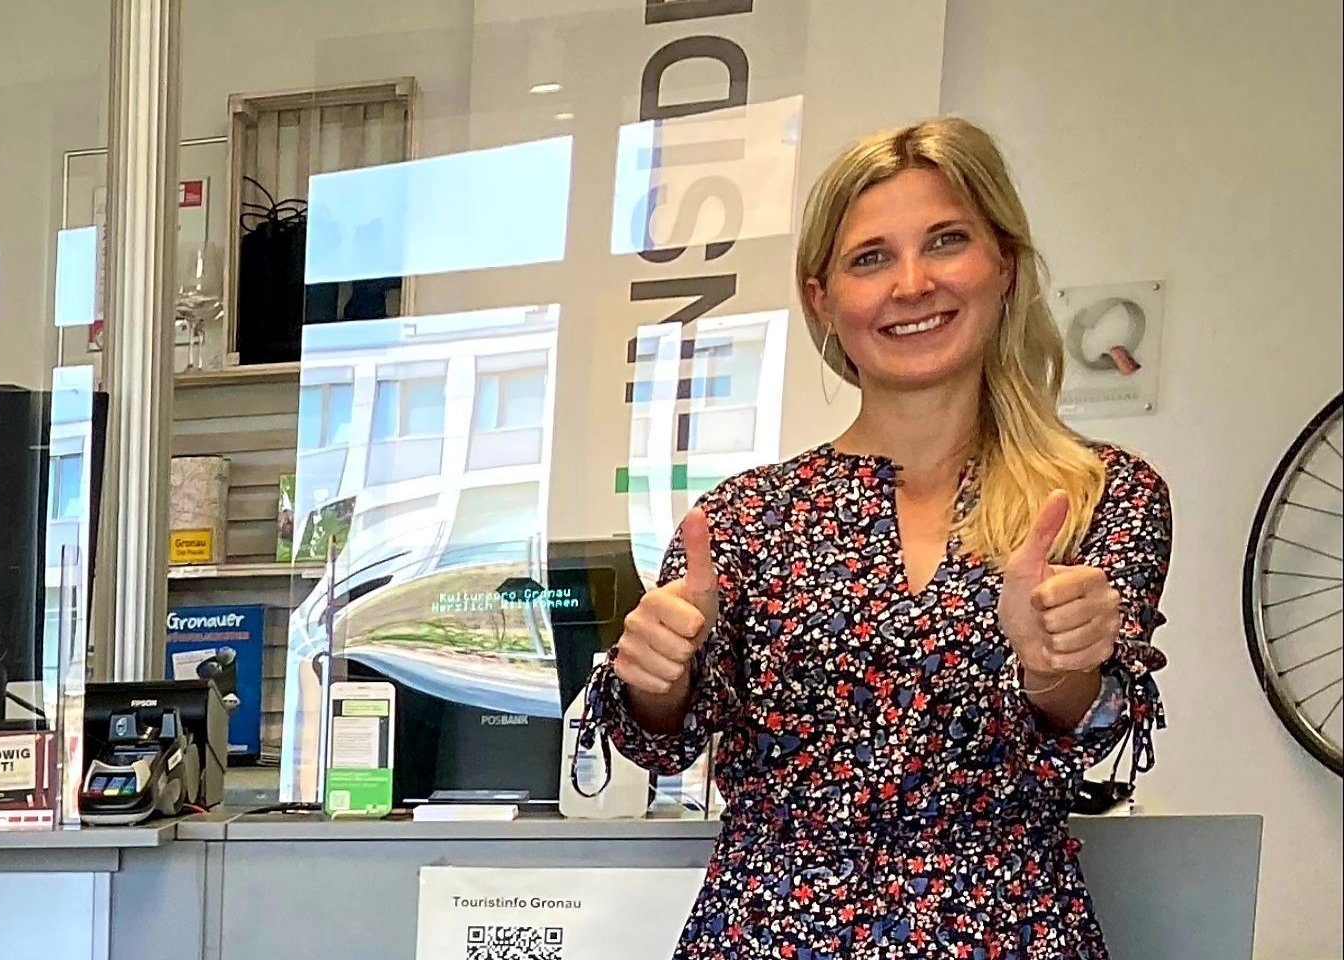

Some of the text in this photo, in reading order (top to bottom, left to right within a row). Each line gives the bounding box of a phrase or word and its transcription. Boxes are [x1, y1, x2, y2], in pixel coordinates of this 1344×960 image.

[166, 611, 246, 630] Gronauer
[480, 714, 529, 726] POSBANK
[452, 895, 582, 909] Touristinfo Gronau
